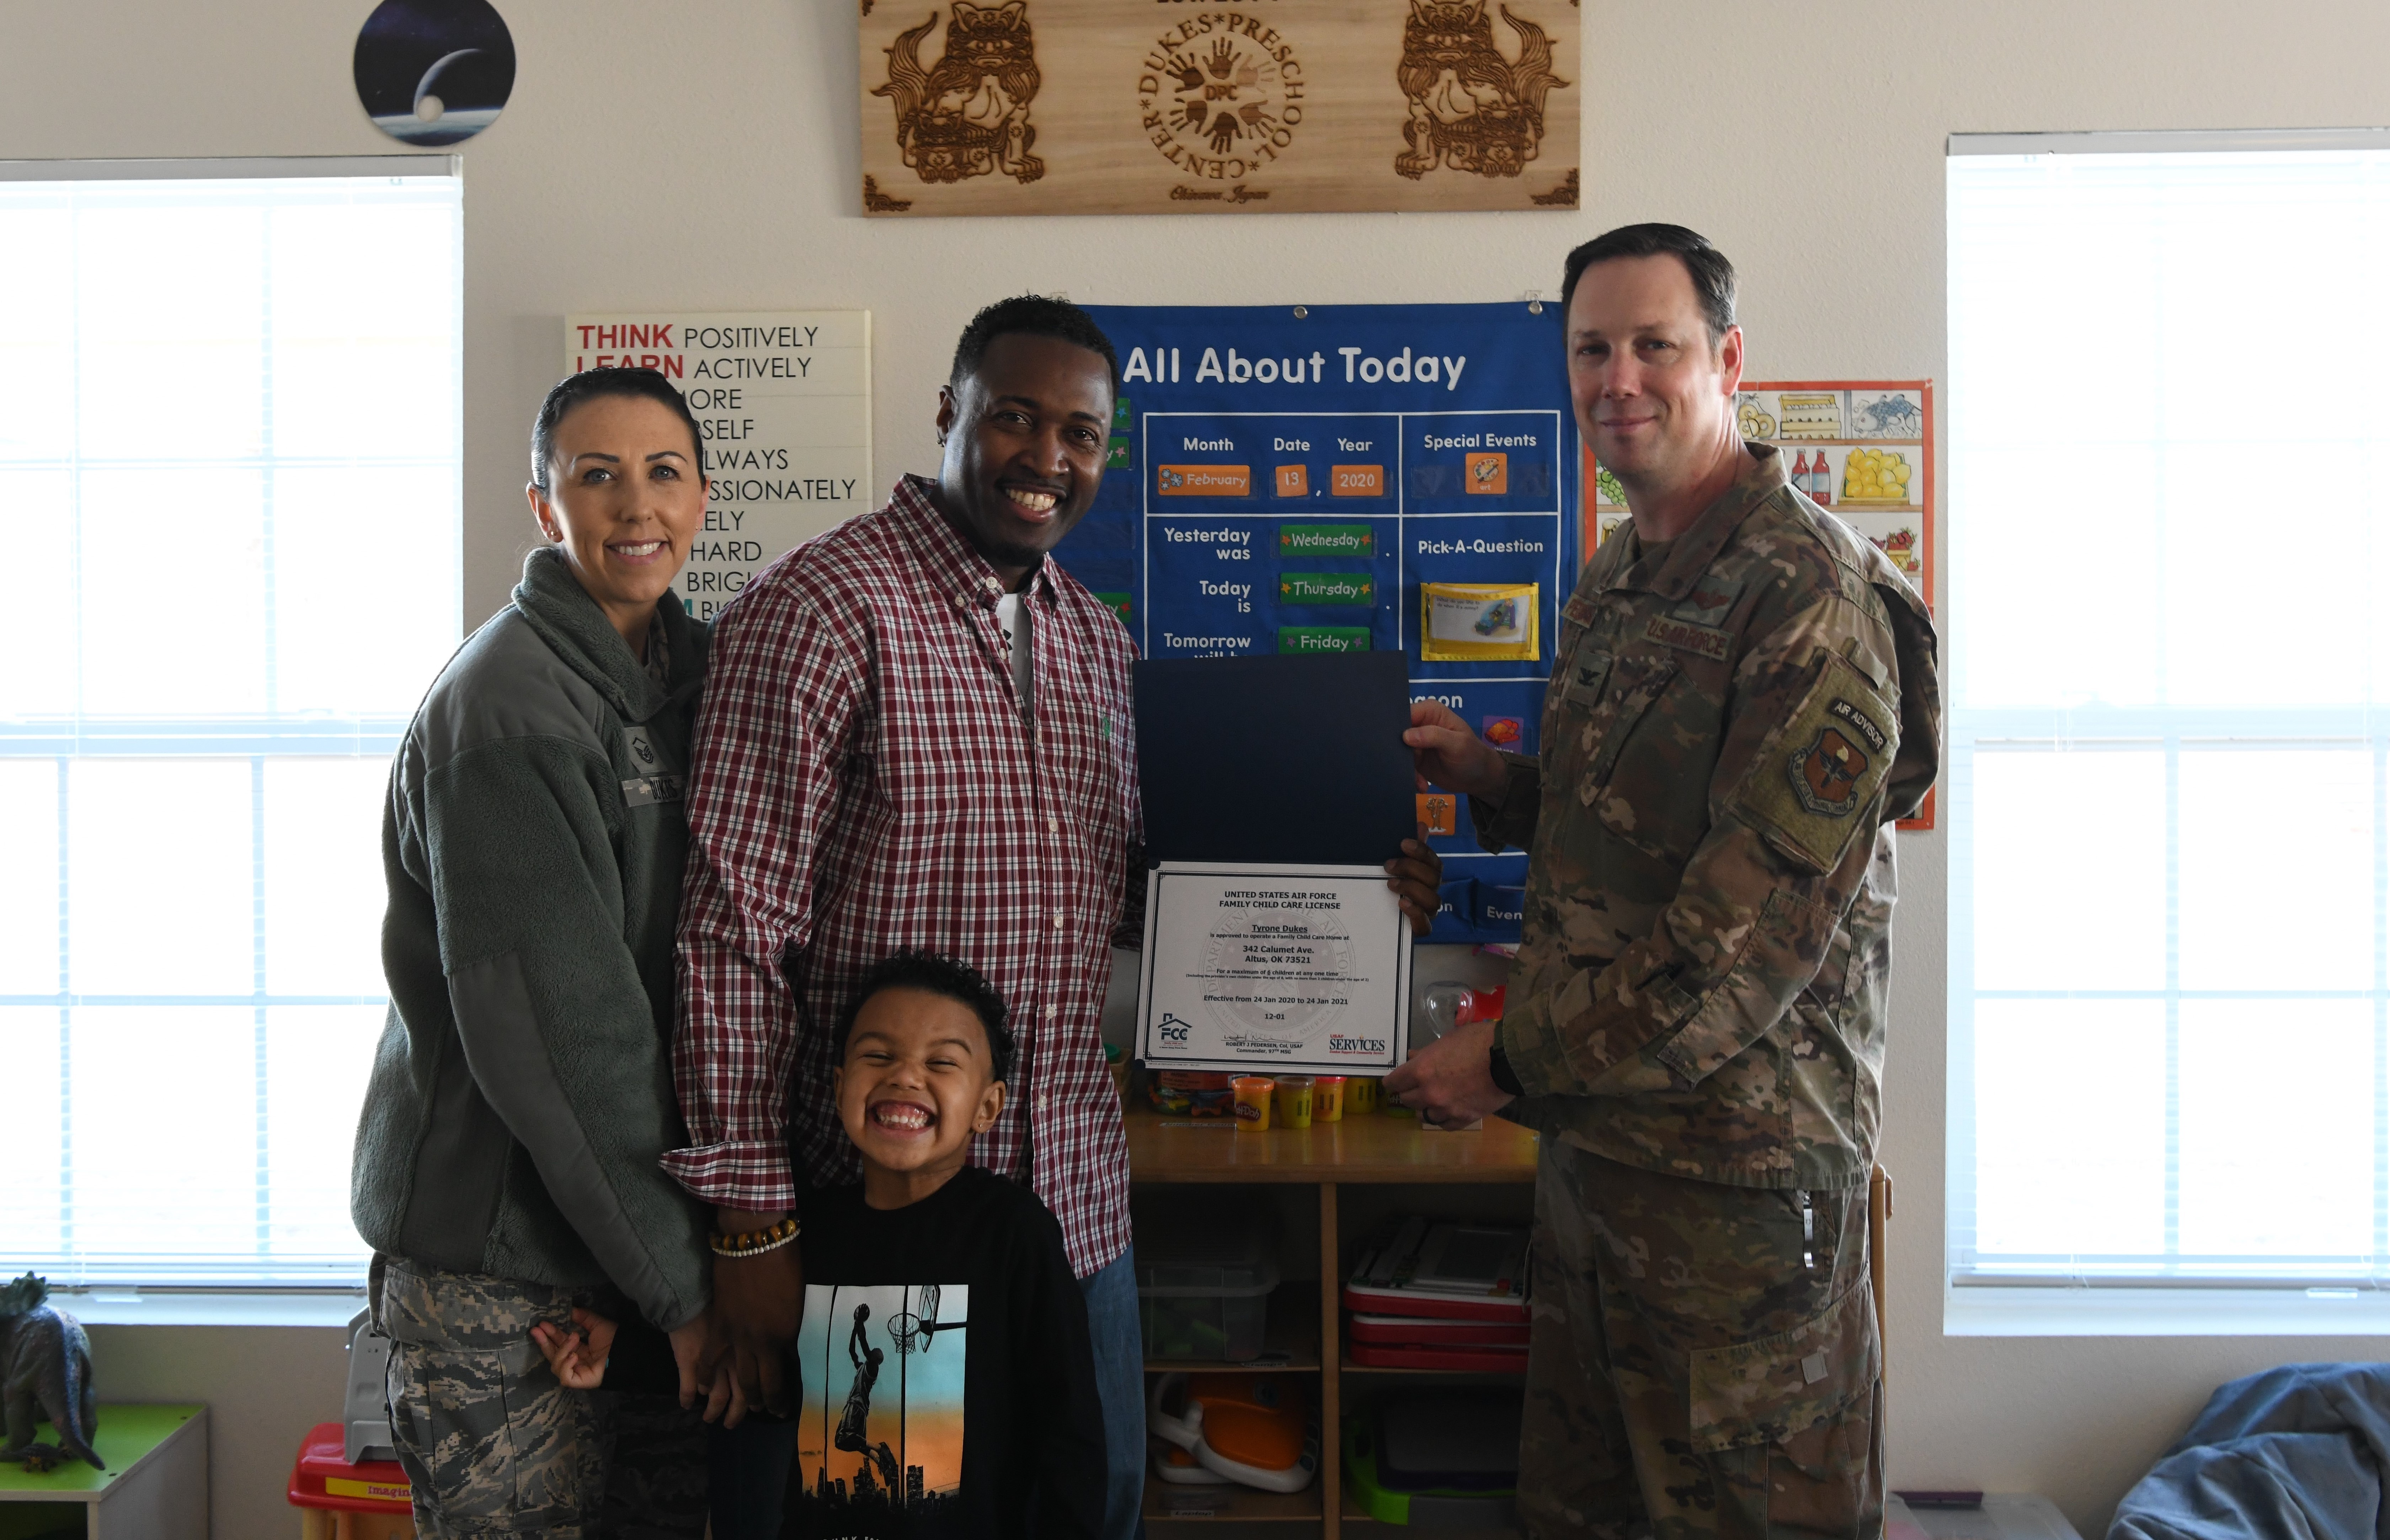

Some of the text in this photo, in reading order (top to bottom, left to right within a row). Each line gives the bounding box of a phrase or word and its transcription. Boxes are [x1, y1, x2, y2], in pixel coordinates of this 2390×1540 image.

[1139, 13, 1304, 179] DUKES PRESCHOOL CENTER
[1204, 85, 1238, 101] DPC
[577, 324, 818, 349] THINK POSITIVELY
[693, 357, 811, 379] ACTIVELY
[1122, 347, 1466, 391] All About Today
[687, 389, 742, 410] ORE
[702, 419, 754, 440] SELF
[1184, 437, 1373, 451] Month Date Year
[1424, 433, 1537, 450] Special Events
[705, 449, 788, 470] LWAYS
[1187, 472, 1375, 488] February 13 2020
[709, 479, 856, 501] SSIONATELY
[703, 511, 745, 531] ELY
[1164, 528, 1251, 546] Yesterday
[1216, 532, 1360, 560] was Wednesday
[1418, 539, 1543, 554] Pick-A-Question
[690, 541, 762, 561] HARD
[1199, 581, 1358, 599] Today Thursday
[701, 601, 730, 621] BI
[1238, 599, 1251, 613] is
[1163, 633, 1349, 652] Tomorrow Friday
[1252, 924, 1280, 933] Tyrone
[1245, 955, 1268, 964] Altus,
[1161, 1028, 1188, 1040] FCC
[1329, 1038, 1385, 1051] SERVICES
